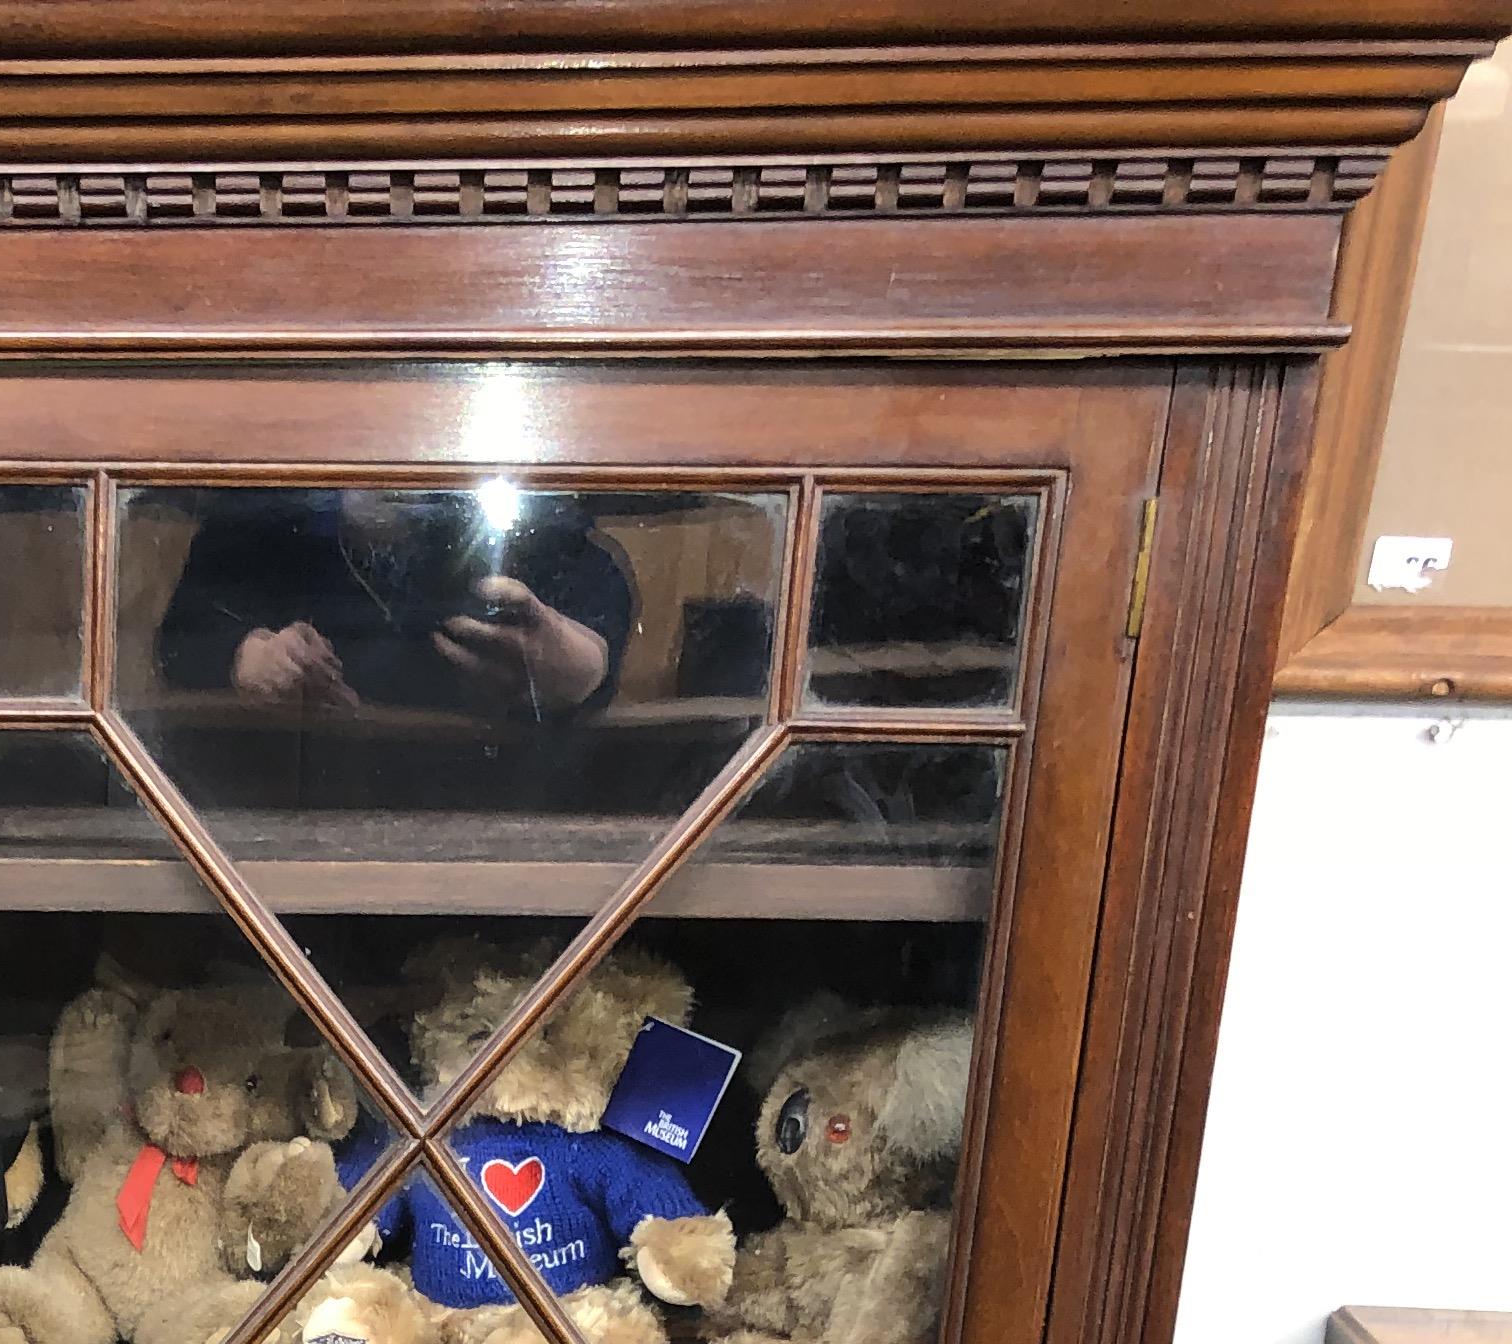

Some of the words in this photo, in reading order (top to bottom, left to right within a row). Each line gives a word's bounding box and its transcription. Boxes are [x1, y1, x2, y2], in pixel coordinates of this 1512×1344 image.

[659, 1110, 672, 1120] THE
[644, 1120, 687, 1150] MUSEUM
[658, 1119, 688, 1138] BRITISH
[430, 1222, 461, 1248] The
[460, 1239, 585, 1279] Meum
